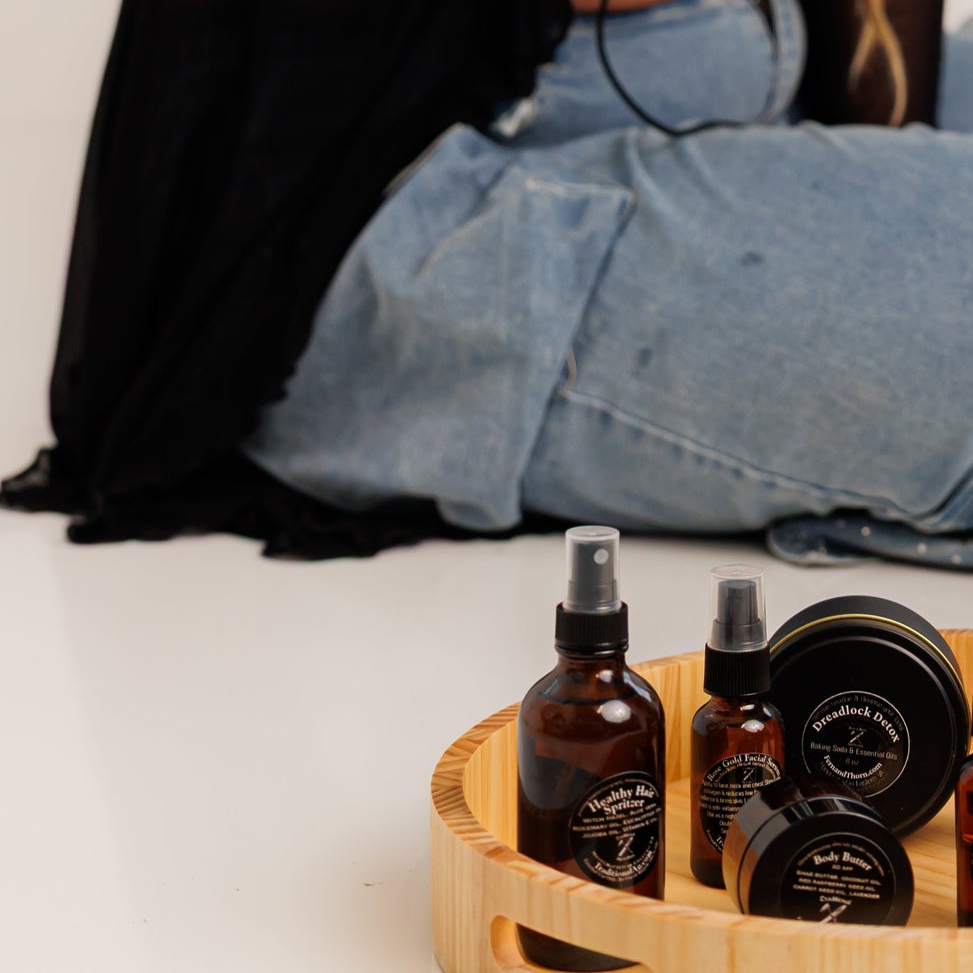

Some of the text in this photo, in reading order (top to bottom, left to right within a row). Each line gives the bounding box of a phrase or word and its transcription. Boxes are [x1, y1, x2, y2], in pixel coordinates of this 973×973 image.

[812, 705, 871, 732] Dreadlock
[873, 712, 900, 743] Detox
[810, 742, 831, 752] Baking
[832, 745, 847, 754] Soda
[856, 748, 884, 757] Essential
[707, 766, 722, 781] Rose
[722, 755, 742, 767] Gold
[744, 754, 766, 763] Facial
[824, 754, 882, 780] FernandThorn.com
[587, 788, 633, 813] Healthy
[636, 785, 655, 799] Hair
[604, 799, 645, 816] Spritzer
[813, 851, 840, 865] Body
[842, 852, 872, 870] Butter
